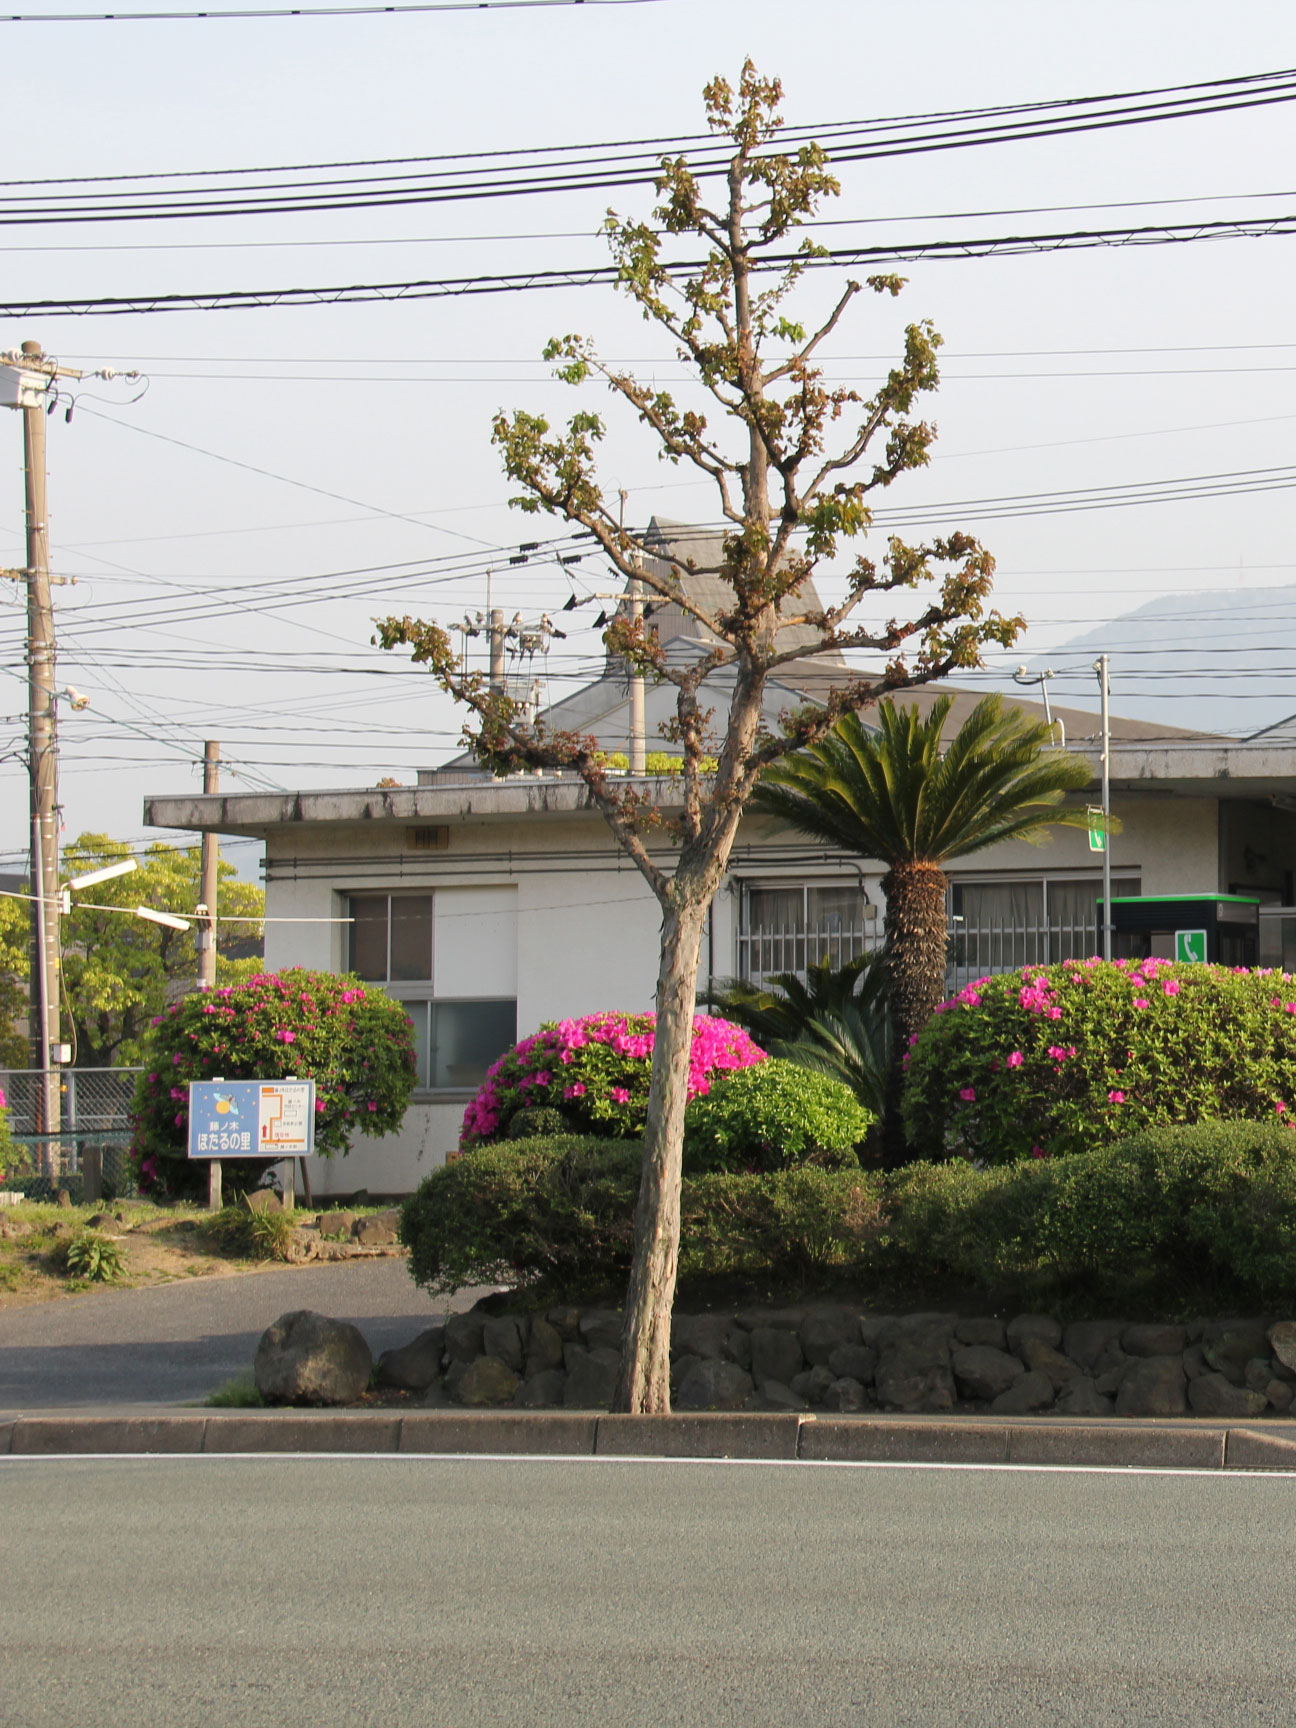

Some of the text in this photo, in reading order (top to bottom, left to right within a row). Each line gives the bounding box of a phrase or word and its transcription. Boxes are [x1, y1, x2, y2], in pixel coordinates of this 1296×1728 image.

[209, 1121, 239, 1132] 藤ノ木
[197, 1131, 251, 1151] ほたるの里
